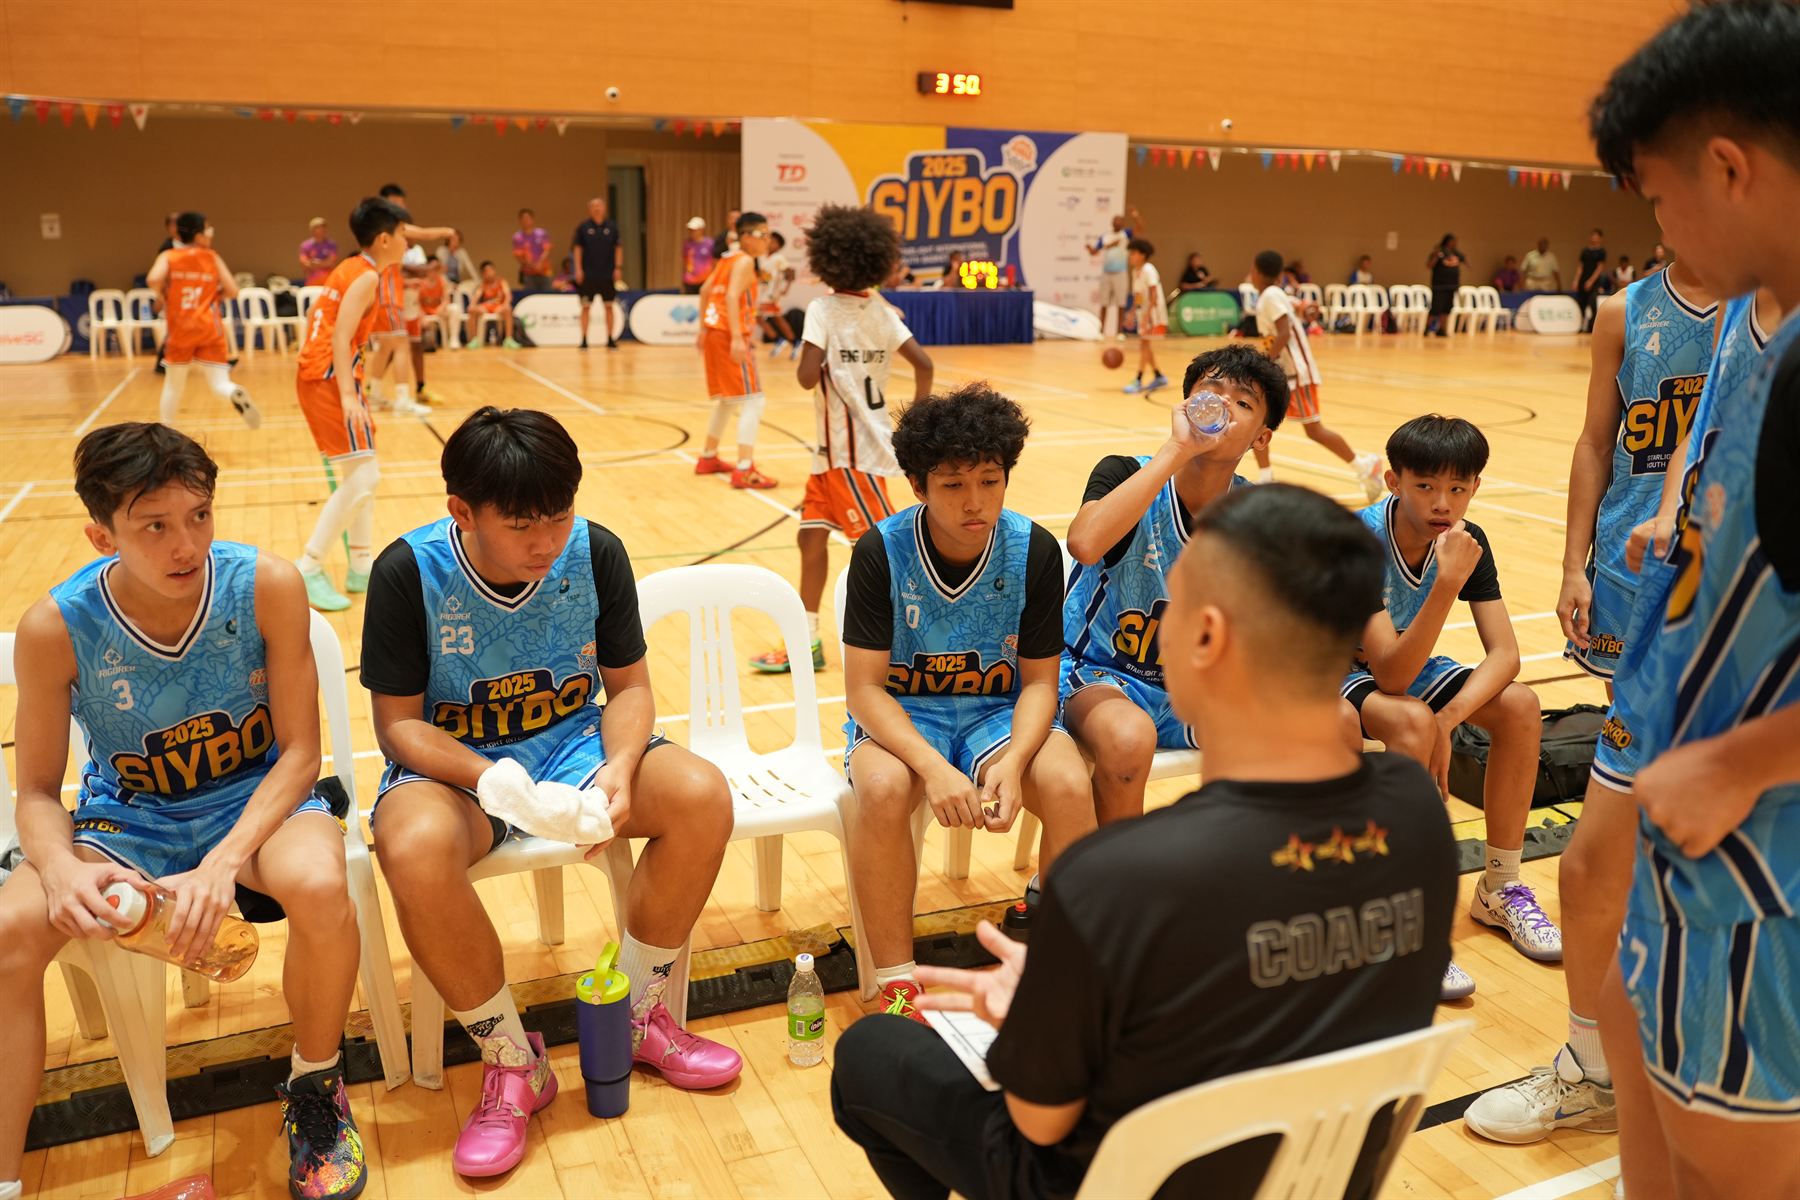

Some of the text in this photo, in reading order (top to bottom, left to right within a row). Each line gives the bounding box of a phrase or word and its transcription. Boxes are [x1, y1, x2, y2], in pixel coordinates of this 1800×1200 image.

[922, 155, 968, 177] 2025
[873, 175, 1017, 240] SIYBO
[1645, 331, 1661, 356] 4
[1673, 376, 1707, 395] 202
[1625, 397, 1700, 452] SIY
[906, 604, 920, 629] 0
[440, 625, 475, 656] 23
[885, 664, 1011, 694] SIYBO
[925, 655, 967, 673] 2025
[112, 679, 135, 710] 3
[487, 672, 536, 700] 2025
[162, 716, 215, 749] 2025
[115, 708, 274, 794] SIYBO
[1246, 887, 1425, 988] COACH
